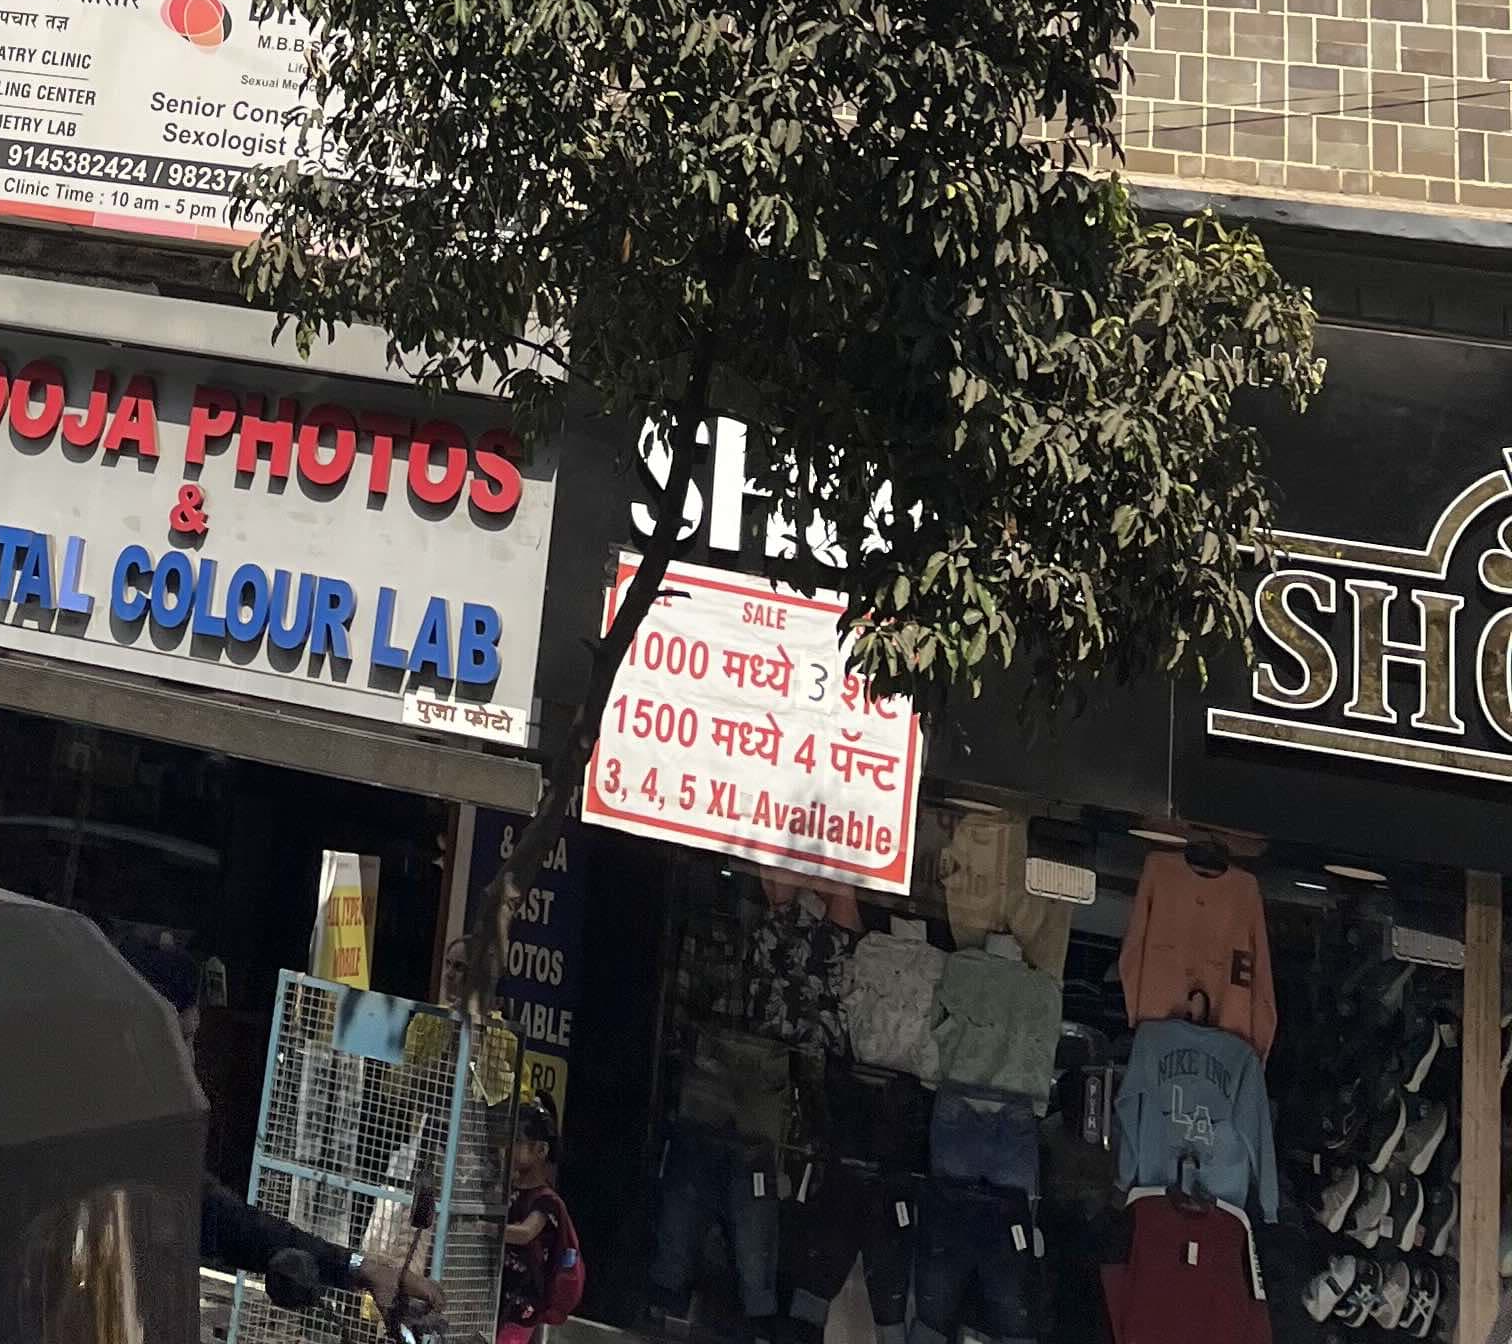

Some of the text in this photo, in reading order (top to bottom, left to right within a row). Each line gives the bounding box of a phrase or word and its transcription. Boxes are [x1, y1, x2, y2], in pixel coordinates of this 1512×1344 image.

[42, 49, 92, 70] CLINIC
[37, 84, 96, 106] CENTER
[241, 74, 278, 88] Sexual
[150, 92, 226, 119] Senior
[47, 119, 77, 137] LAB
[162, 122, 288, 157] Sexologist
[7, 144, 147, 182] 9145382424
[4, 177, 49, 198] Clinic
[55, 183, 94, 203] Time
[111, 190, 129, 208] 10
[134, 197, 159, 211] am
[176, 197, 186, 214] 5
[190, 202, 216, 219] pm
[186, 383, 524, 515] PHOTOS
[169, 484, 208, 536] &
[111, 544, 355, 662] COLOUR
[370, 587, 503, 686] LAB
[742, 601, 788, 631] SALE
[628, 631, 829, 702] 1000 मध्ये 3
[464, 704, 513, 733] फोटो
[613, 694, 900, 792] 1500 मध्ये 4 पॅन्ट
[604, 757, 629, 802] 3,
[641, 766, 666, 810] 4,
[679, 773, 697, 810] 5
[706, 779, 740, 821] XL
[752, 790, 893, 855] Available
